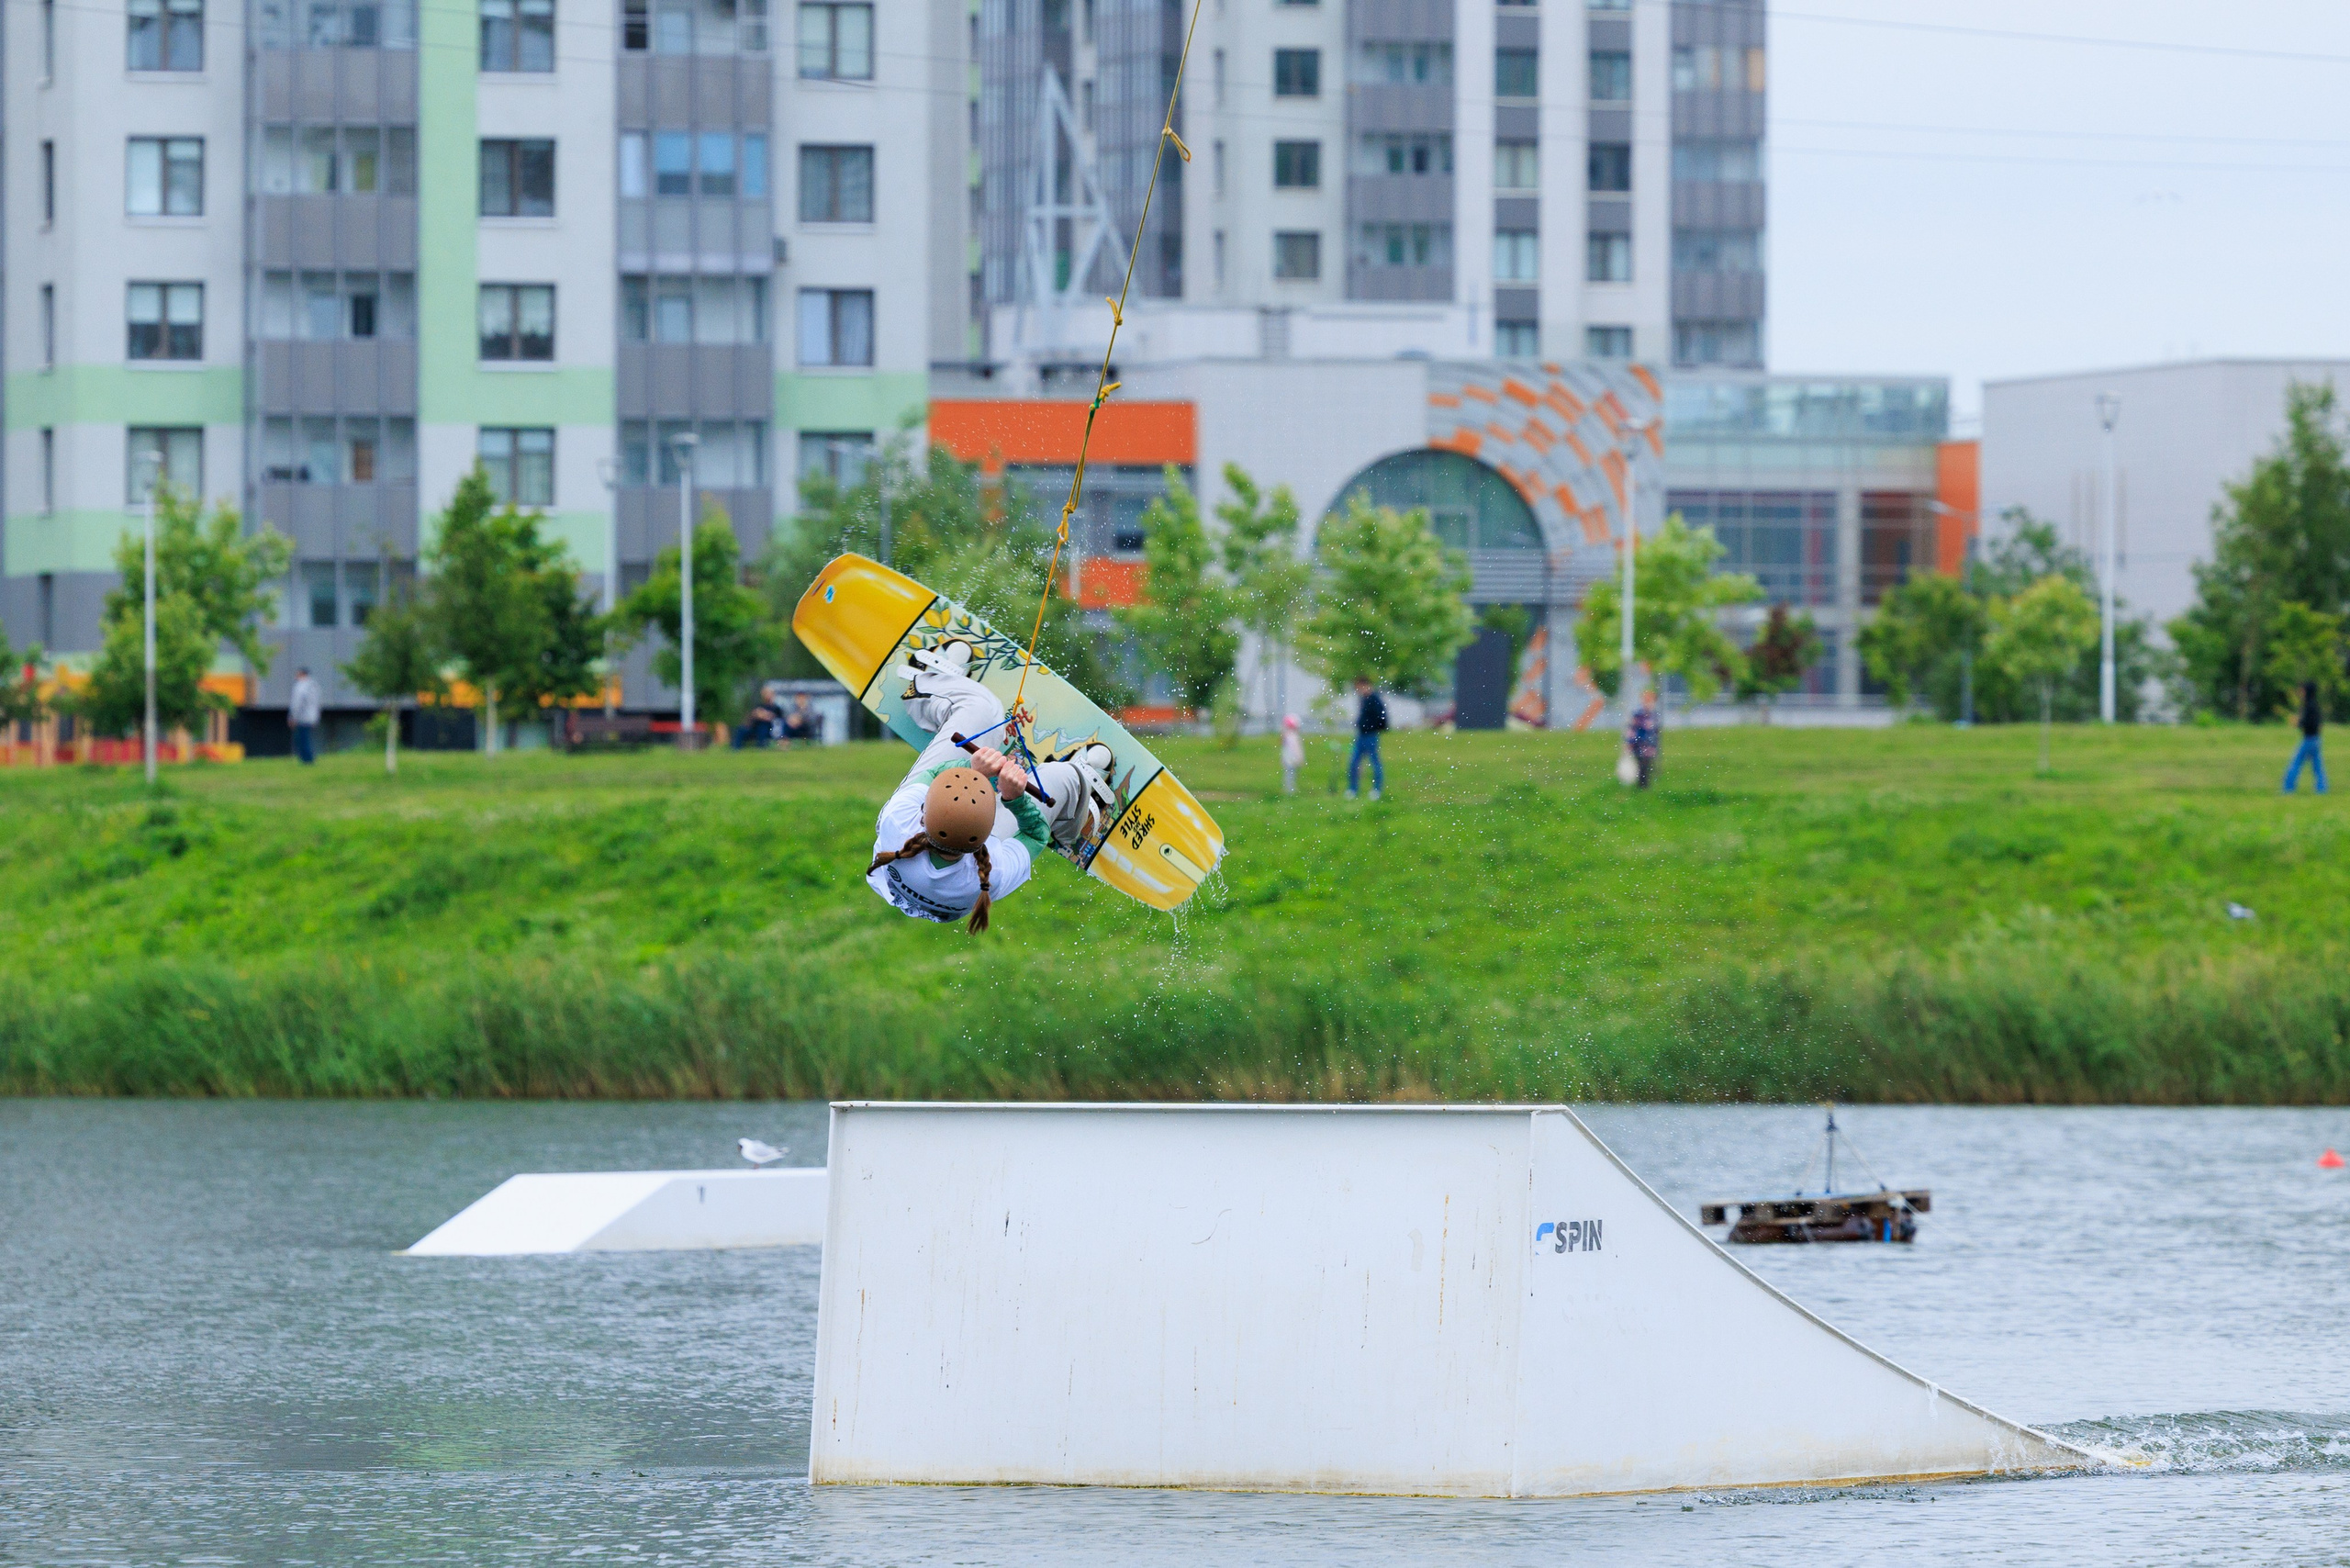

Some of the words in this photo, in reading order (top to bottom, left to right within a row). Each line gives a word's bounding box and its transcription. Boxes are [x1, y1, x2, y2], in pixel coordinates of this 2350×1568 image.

[1120, 804, 1141, 839] STYLE
[1132, 813, 1155, 850] SHRED
[1554, 1219, 1603, 1254] SPIN
